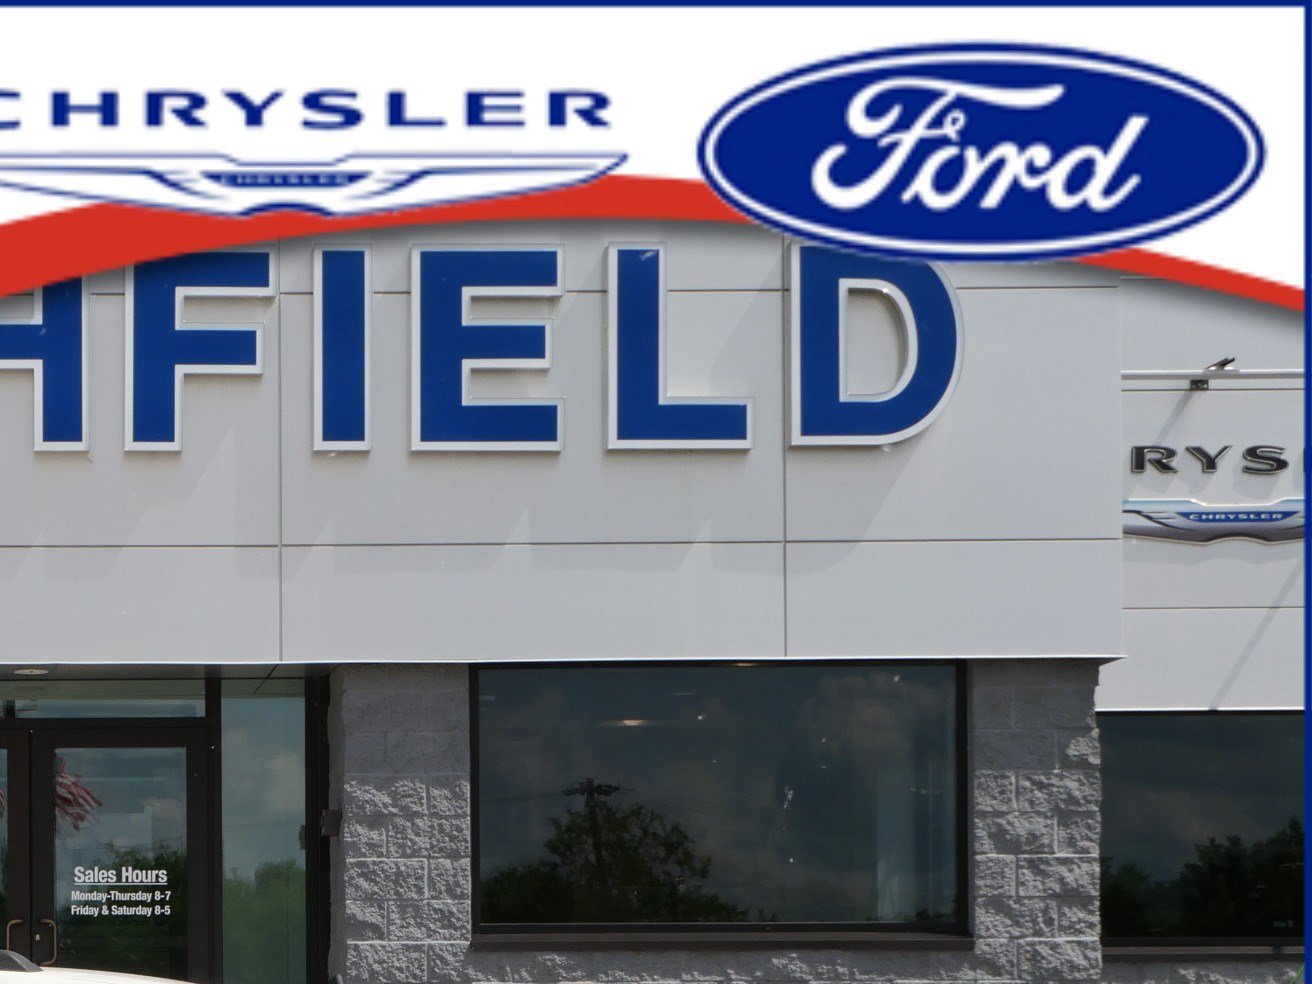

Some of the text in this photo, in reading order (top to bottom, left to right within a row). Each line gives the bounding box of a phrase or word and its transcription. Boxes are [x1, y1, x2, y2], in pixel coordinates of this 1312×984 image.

[1189, 512, 1283, 520] CHRYSLER
[74, 866, 168, 883] Sales Hours
[71, 890, 171, 902] Monday-Thursday 8-7
[71, 905, 171, 917] Friday & Saturday 8-5
